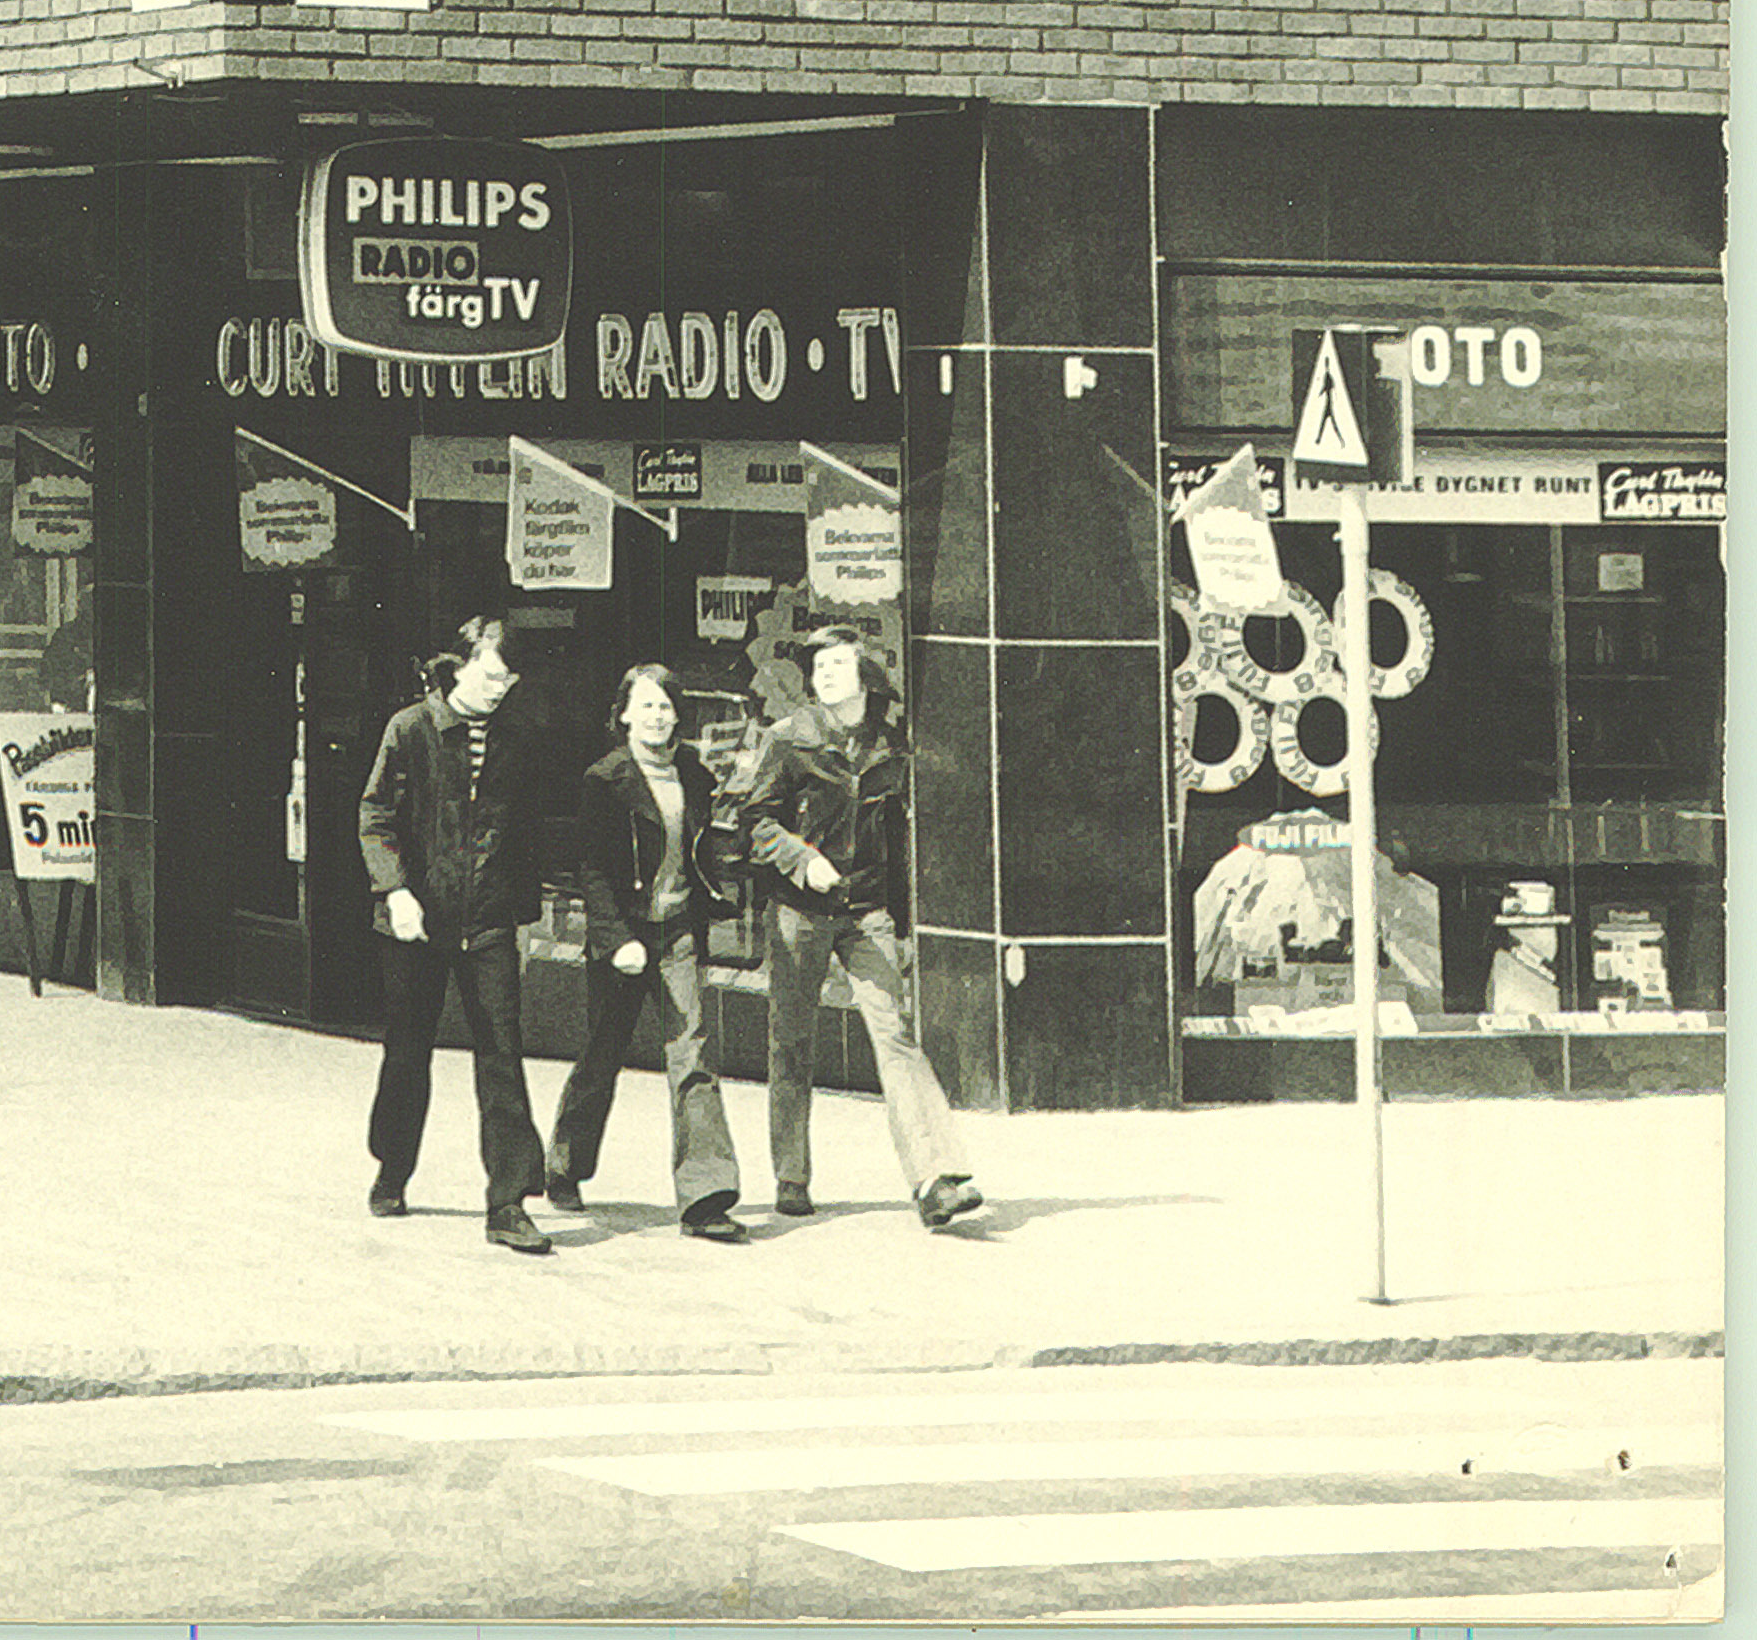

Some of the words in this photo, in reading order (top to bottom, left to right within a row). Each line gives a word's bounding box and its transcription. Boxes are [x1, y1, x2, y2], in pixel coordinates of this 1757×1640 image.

[347, 175, 552, 231] PHILIPS
[360, 243, 477, 279] RADIO
[598, 309, 788, 402] RADIO
[1410, 324, 1544, 389] OTO
[1436, 476, 1524, 494] DYGNET
[1533, 476, 1593, 494] RUNT
[525, 498, 580, 515] Kodak
[524, 541, 575, 559] köper
[523, 563, 545, 578] du
[19, 801, 49, 846] 5
[1250, 822, 1302, 849] FUJI
